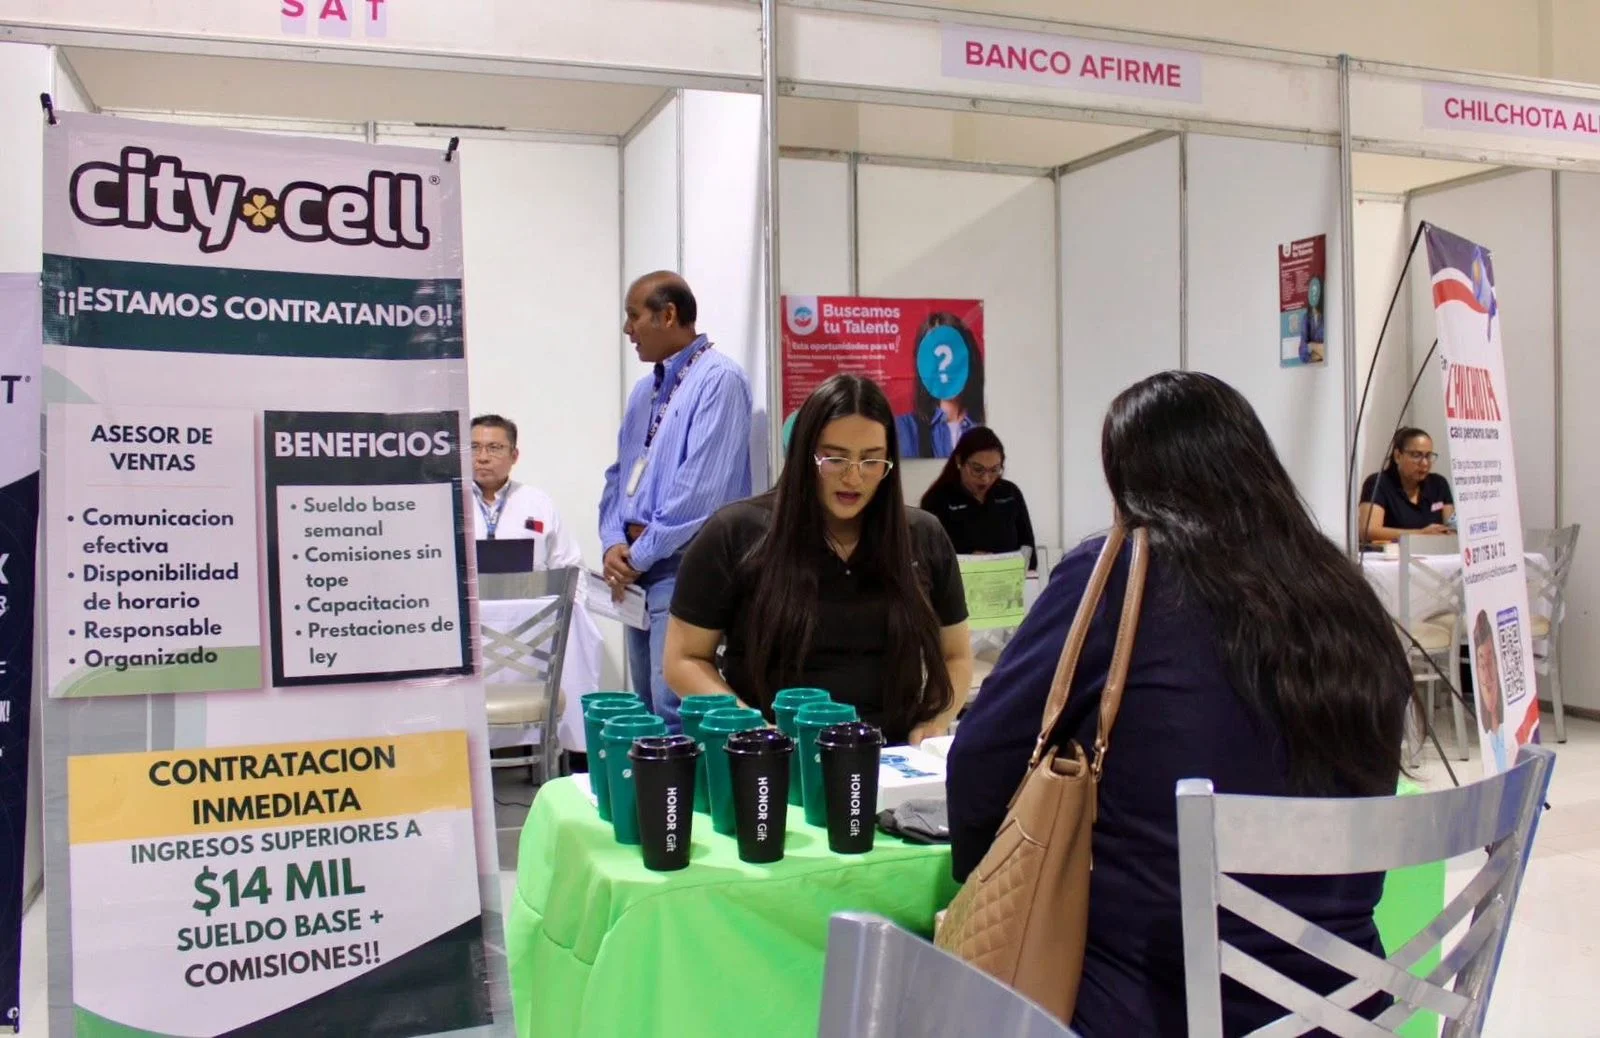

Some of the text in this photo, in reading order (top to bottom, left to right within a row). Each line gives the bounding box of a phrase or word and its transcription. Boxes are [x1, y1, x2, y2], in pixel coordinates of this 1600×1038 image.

[966, 40, 1181, 88] BANCO AFIRME
[1444, 97, 1567, 131] CHILCHOTA
[70, 146, 431, 254] city cell
[57, 287, 453, 328] ¡¡ESTAMOS CONTRATANDO!!
[823, 303, 901, 319] Buscamos
[823, 320, 900, 335] tu Talento
[91, 424, 213, 446] ASESOR DE
[274, 430, 451, 458] BENEFICIOS
[110, 453, 196, 473] VENTAS
[83, 507, 234, 529] Comunicacion
[303, 496, 416, 514] Sueldo base
[304, 520, 383, 539] semanal
[83, 536, 169, 555] efectiva
[305, 544, 442, 564] Comisiones sin
[84, 562, 239, 586] Disponibilidad
[306, 573, 349, 593] tope
[84, 591, 200, 612] de horario
[307, 594, 430, 617] Capacitacion
[84, 619, 222, 643] Responsable
[308, 614, 454, 640] Prestaciones de
[84, 647, 218, 673] Organizado
[309, 648, 338, 668] ley
[149, 744, 397, 786] CONTRATACION
[193, 788, 362, 825] INMEDIATA
[757, 776, 769, 842] HONOR Gift
[850, 773, 861, 838] HONOR Gift
[666, 787, 677, 853] HONOR Gift
[131, 819, 422, 864] INGRESOS SUPERIORES A
[193, 857, 366, 917] $14 MIL
[177, 909, 384, 952] SUELDO BASE +
[184, 941, 381, 988] COMISIONES!!
